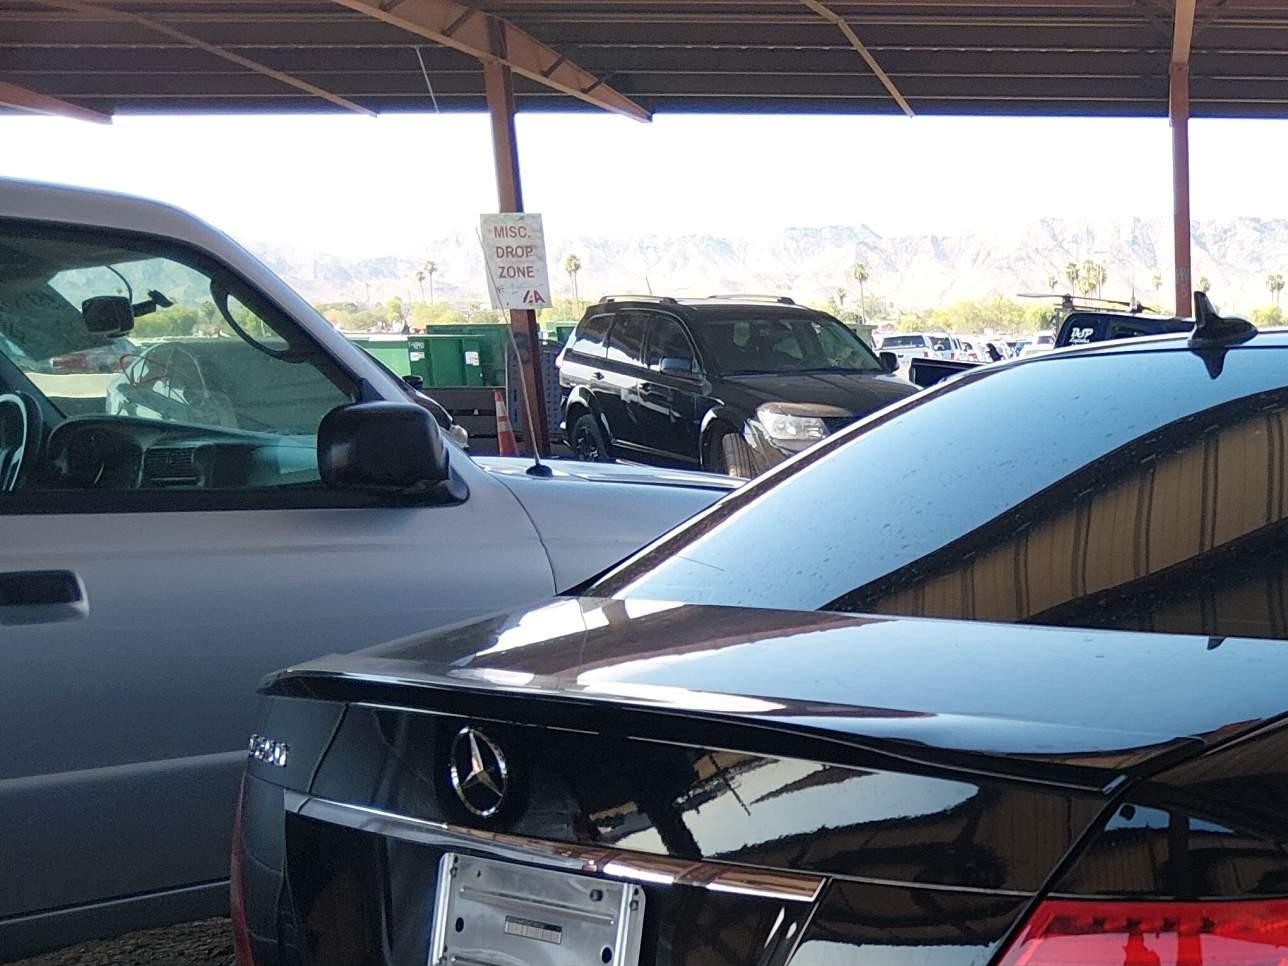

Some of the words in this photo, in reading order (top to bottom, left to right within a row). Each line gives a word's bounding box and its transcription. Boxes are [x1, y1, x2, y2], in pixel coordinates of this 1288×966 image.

[494, 226, 531, 239] MISC.
[496, 246, 534, 259] DROP
[499, 266, 535, 278] ZONE
